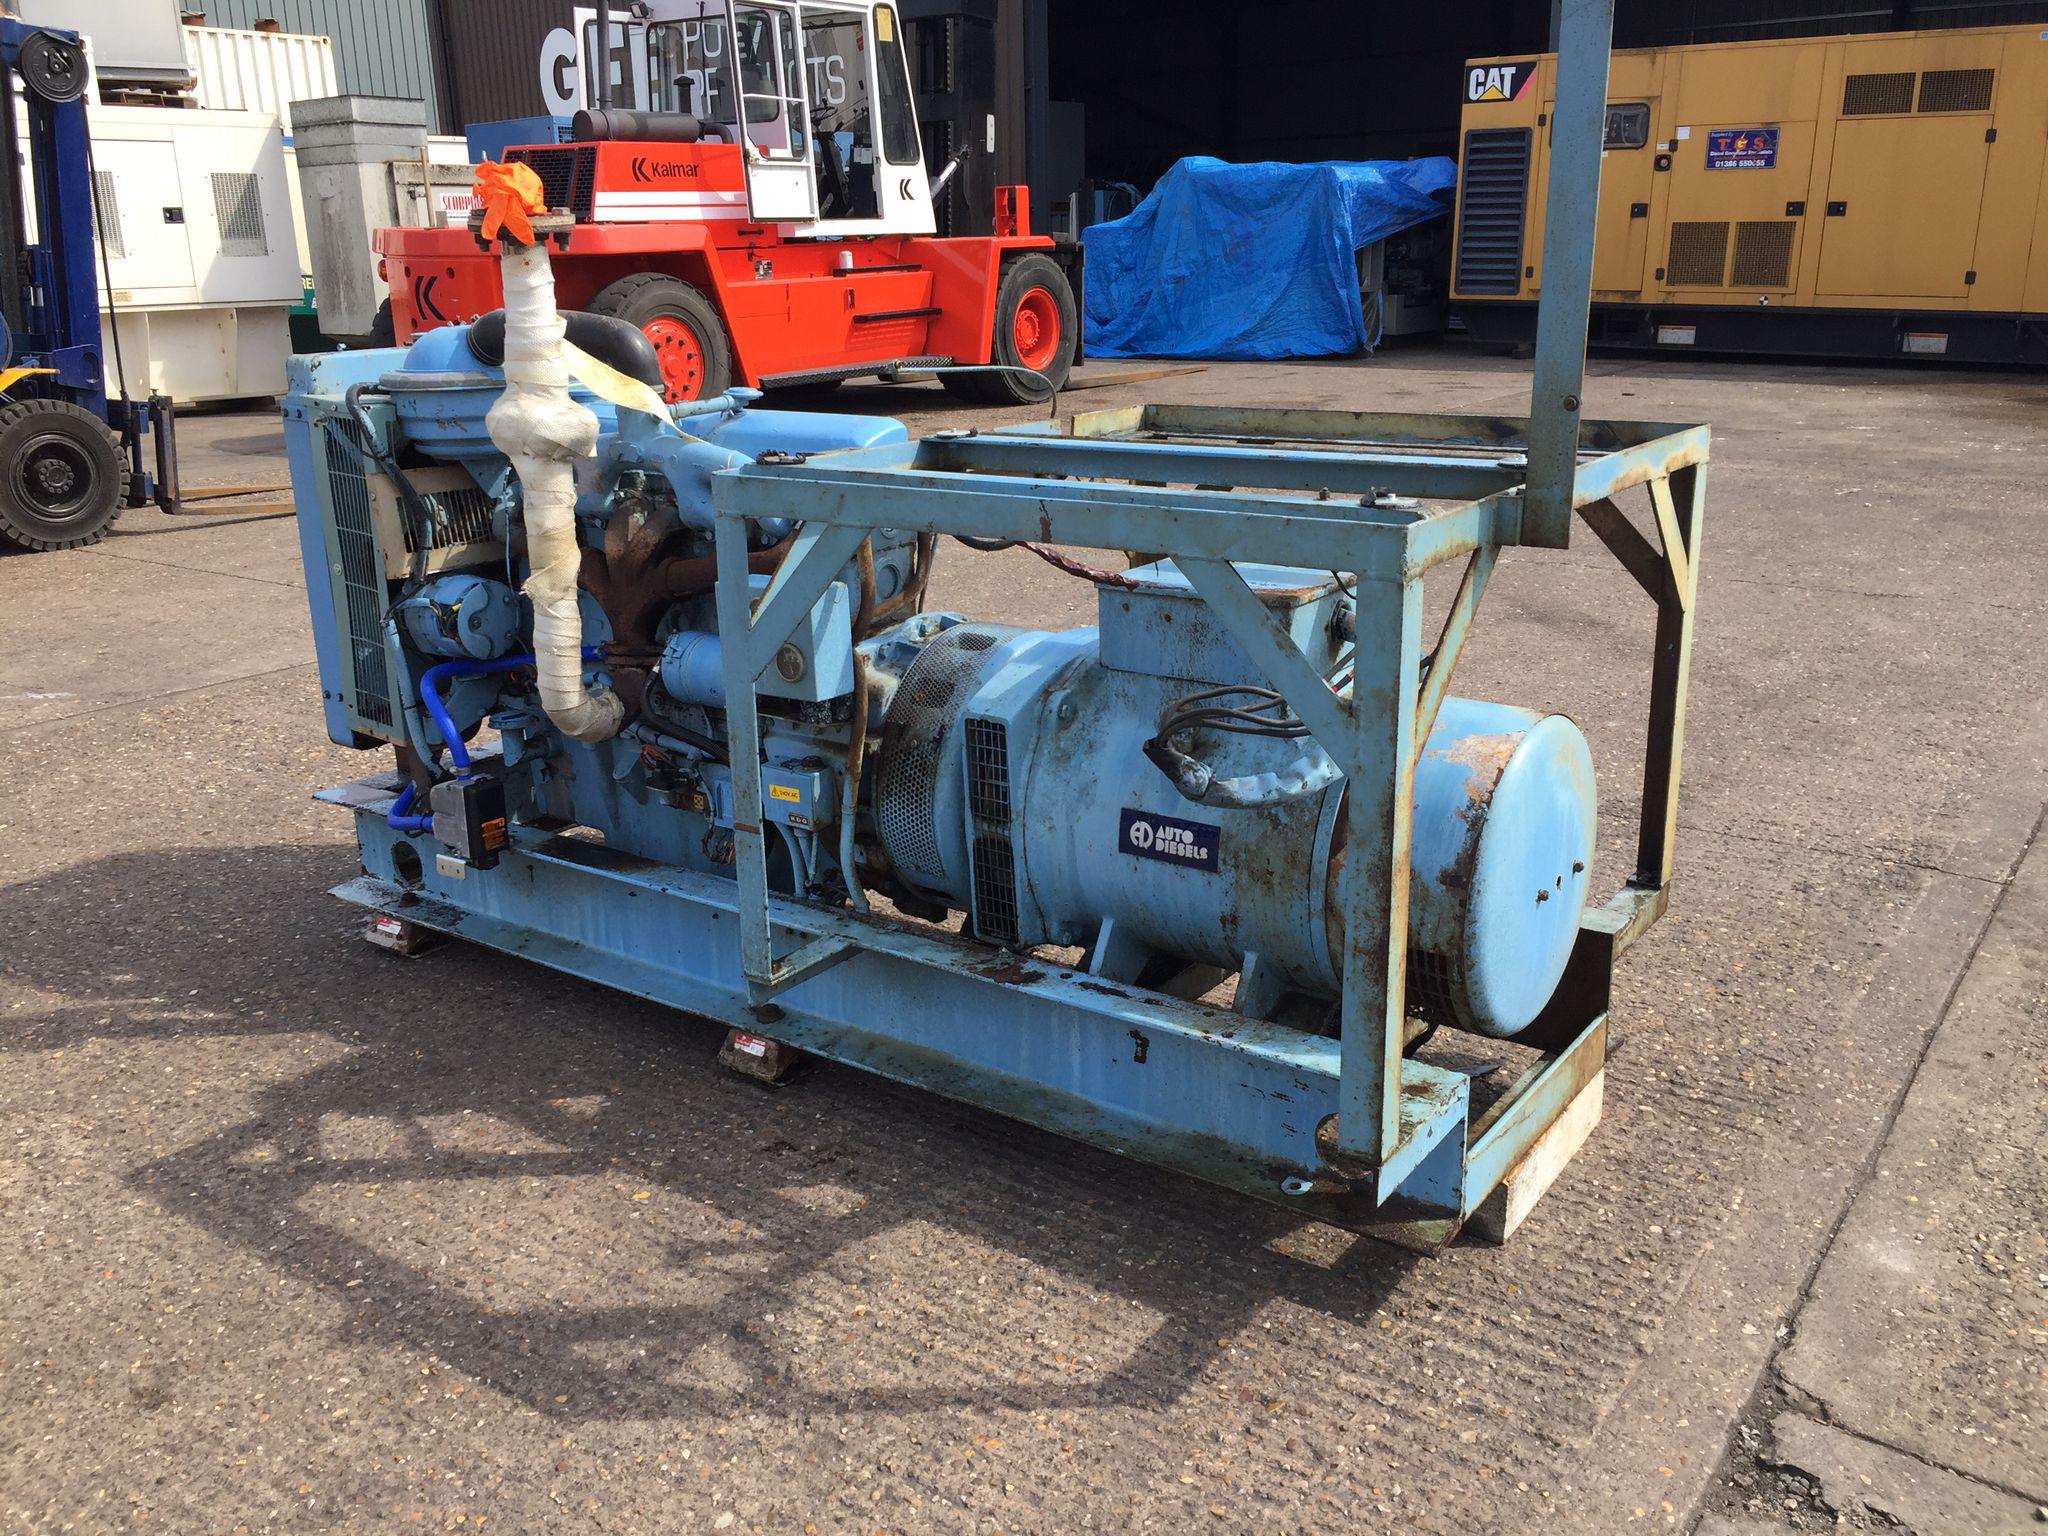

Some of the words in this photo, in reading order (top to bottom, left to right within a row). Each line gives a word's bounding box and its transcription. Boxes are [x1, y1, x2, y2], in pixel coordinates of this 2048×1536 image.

[1469, 67, 1517, 101] CAT
[651, 162, 700, 178] Kalmar
[1155, 825, 1194, 844] AUTO
[1155, 838, 1209, 859] DIESELS
